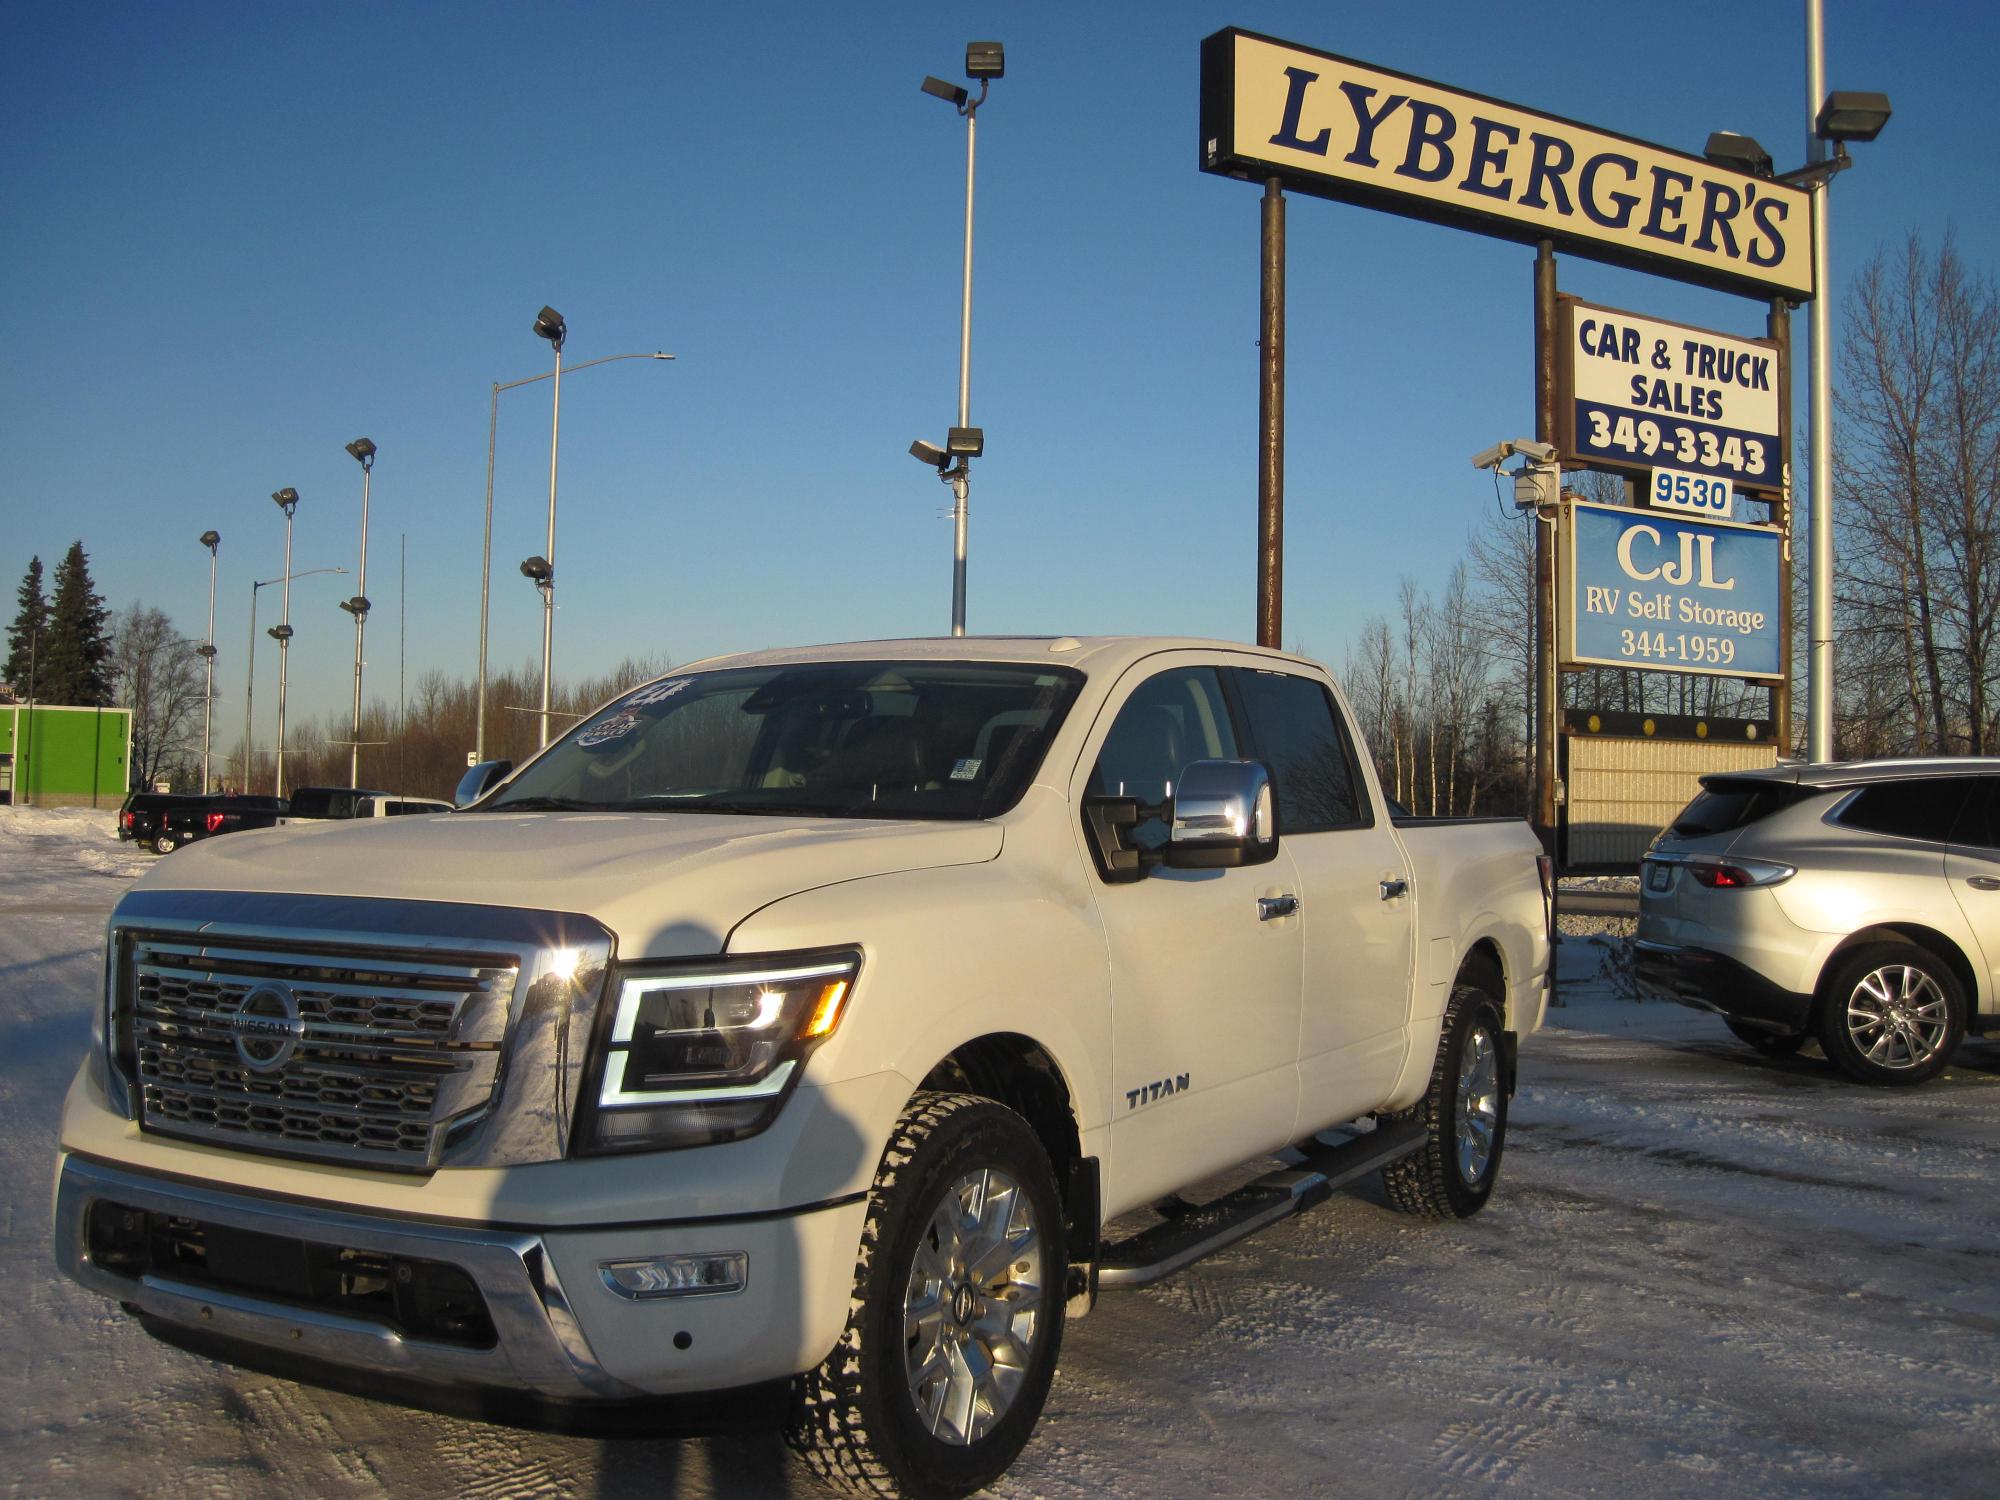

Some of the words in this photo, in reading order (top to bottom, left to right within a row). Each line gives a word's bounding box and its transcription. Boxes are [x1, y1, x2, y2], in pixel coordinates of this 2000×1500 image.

[1269, 65, 1790, 268] LYBERGER'S
[1579, 319, 1641, 365] CAR
[1650, 339, 1672, 371] &
[1682, 340, 1770, 391] TRUCK
[1630, 374, 1723, 421] SALES
[1588, 410, 1766, 475] 349-3343
[1655, 473, 1727, 510] 9530
[1617, 524, 1735, 590] CJL
[1586, 586, 1620, 615] RV
[1627, 591, 1672, 621] Self
[1679, 597, 1764, 634] Storage
[1621, 629, 1735, 664] 344-1959
[234, 1018, 291, 1034] NISSAN
[1126, 1072, 1190, 1110] TITAN
